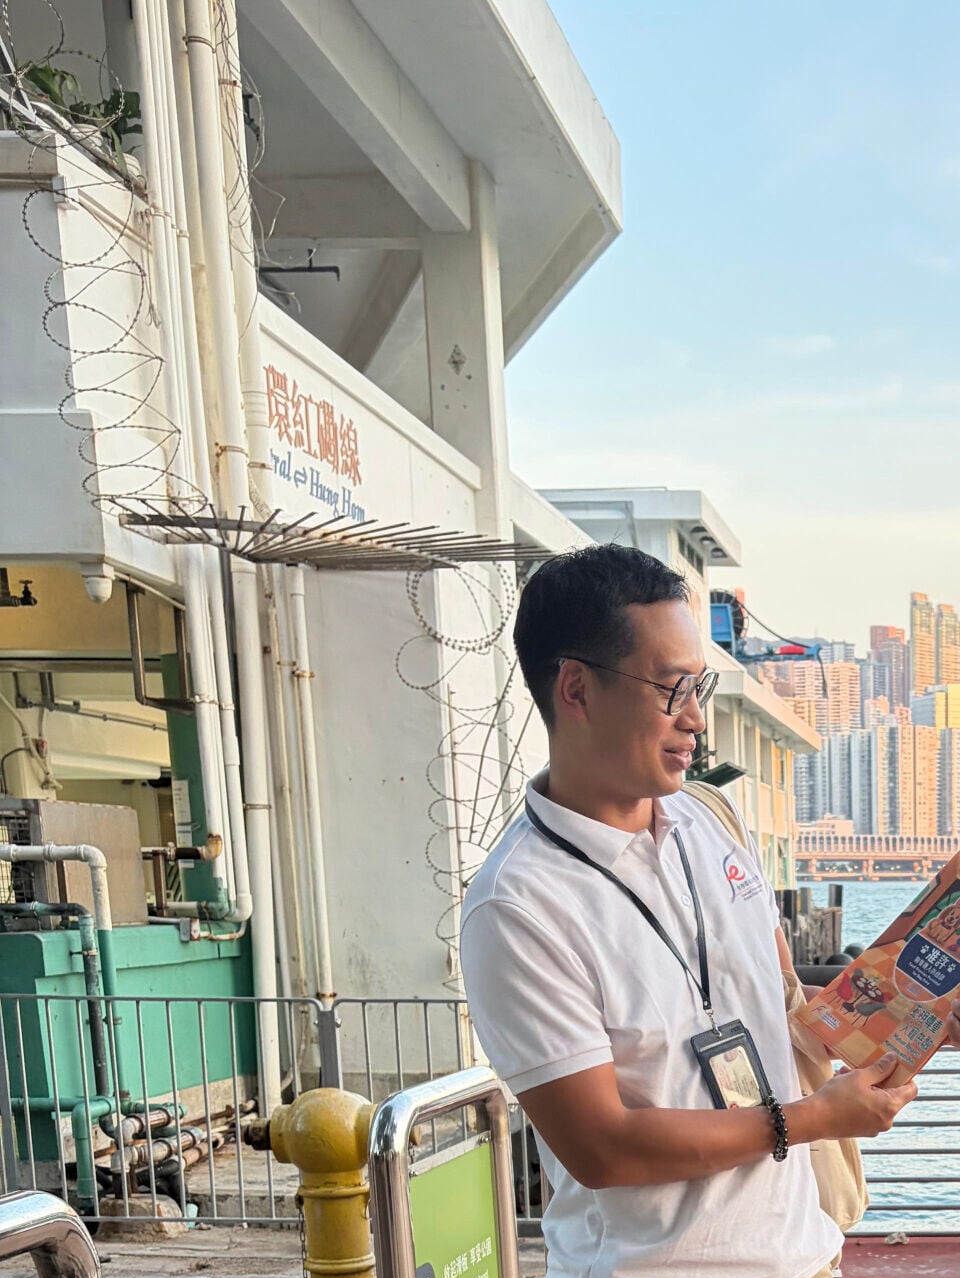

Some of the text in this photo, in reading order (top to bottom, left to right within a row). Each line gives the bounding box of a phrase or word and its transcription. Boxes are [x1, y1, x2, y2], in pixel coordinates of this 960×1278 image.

[309, 467, 340, 517] Hung
[341, 486, 365, 523] Hom
[925, 947, 950, 970] 准許
